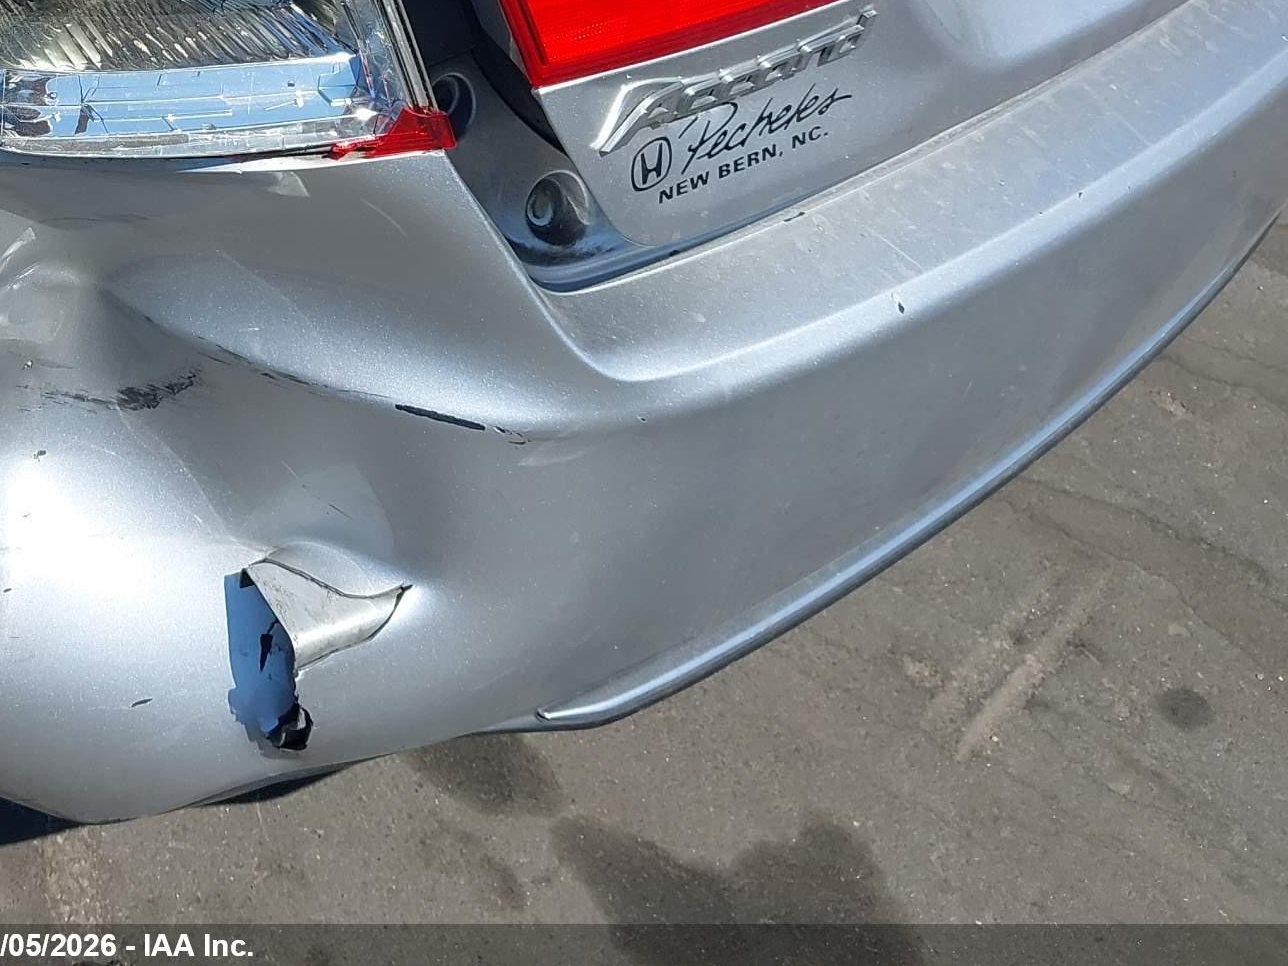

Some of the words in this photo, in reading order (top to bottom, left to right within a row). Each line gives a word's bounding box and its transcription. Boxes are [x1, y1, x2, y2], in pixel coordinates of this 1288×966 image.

[658, 170, 710, 204] NEW
[718, 142, 784, 179] BERN,
[792, 125, 829, 149] NC.
[678, 83, 853, 175] Pecheles
